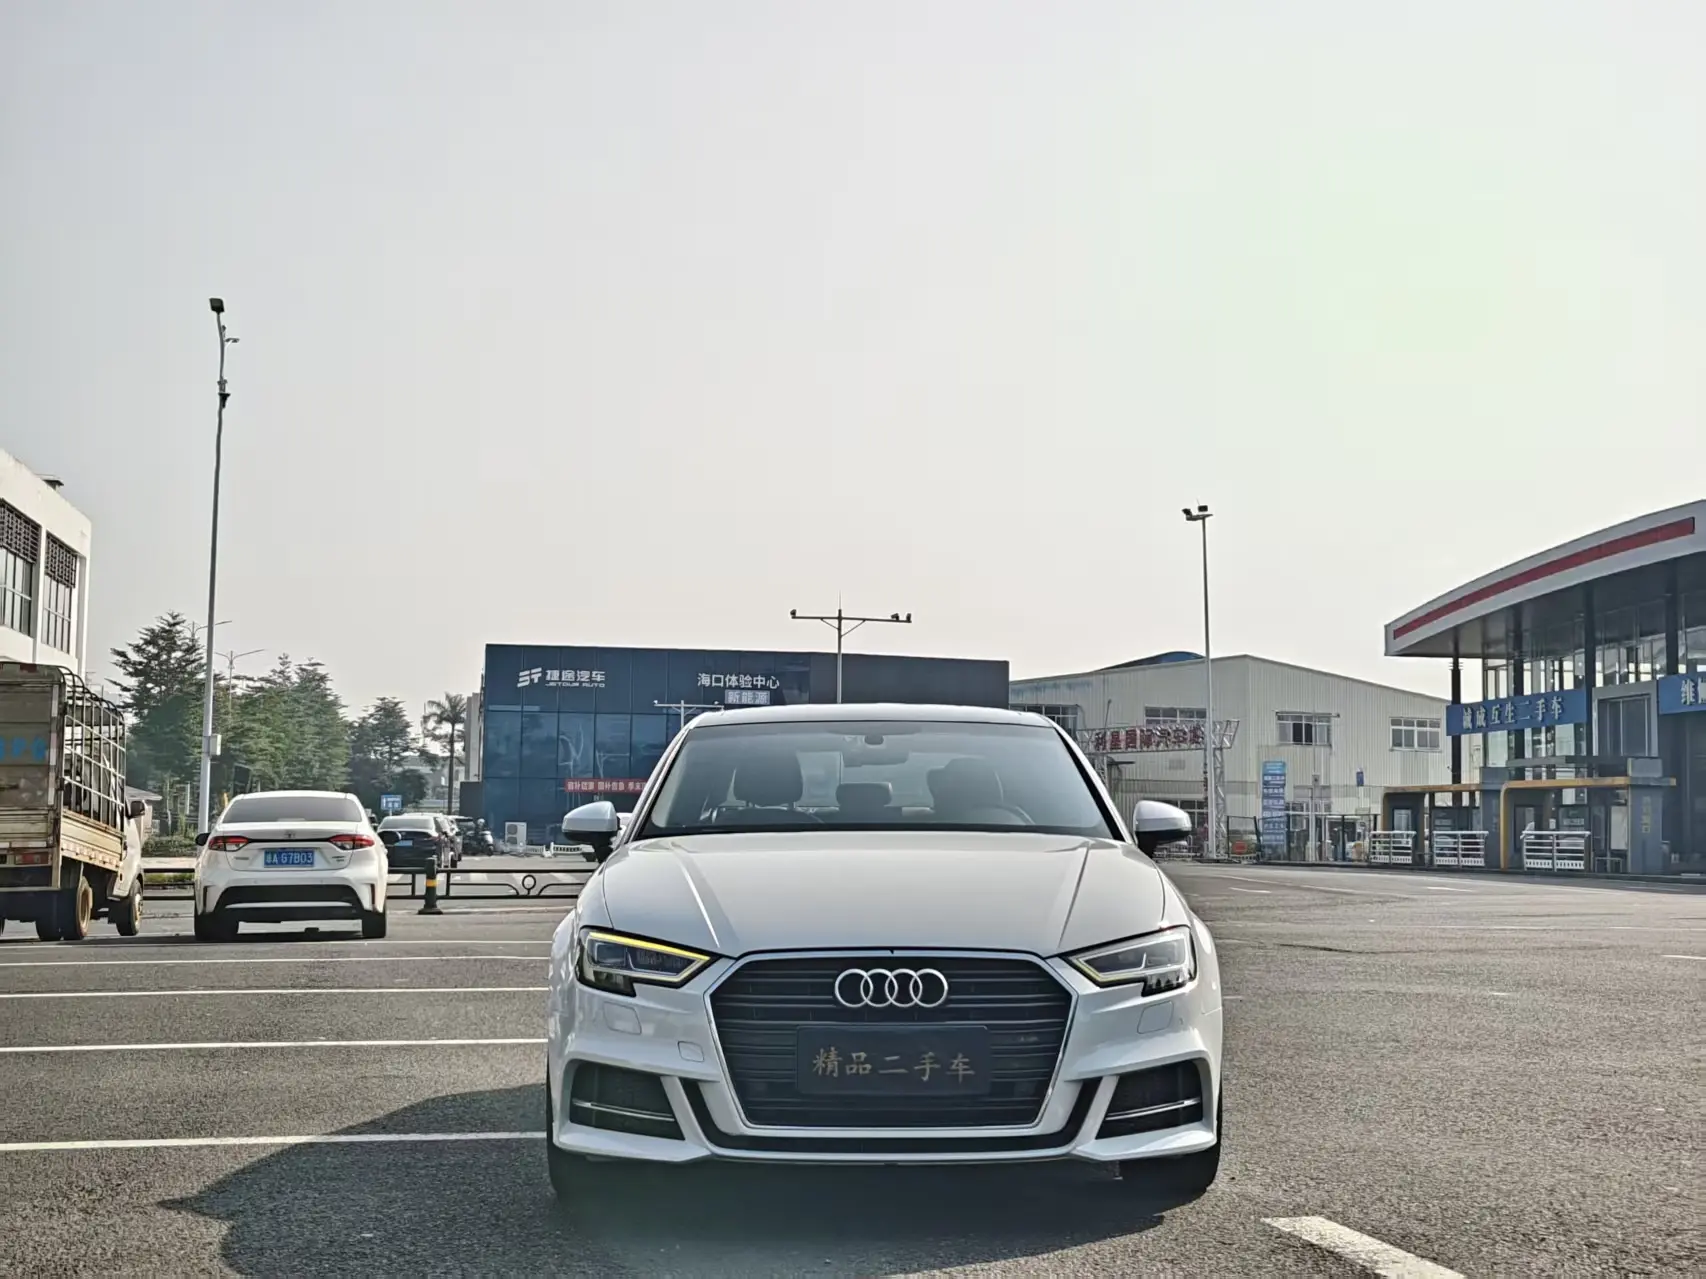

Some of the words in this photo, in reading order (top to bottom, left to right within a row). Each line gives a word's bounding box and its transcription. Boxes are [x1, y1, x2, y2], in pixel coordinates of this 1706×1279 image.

[545, 669, 606, 682] 捷途汽车
[697, 673, 780, 689] 海口体验中心
[727, 691, 768, 705] 新能源
[812, 1046, 975, 1084] 精品二手车
